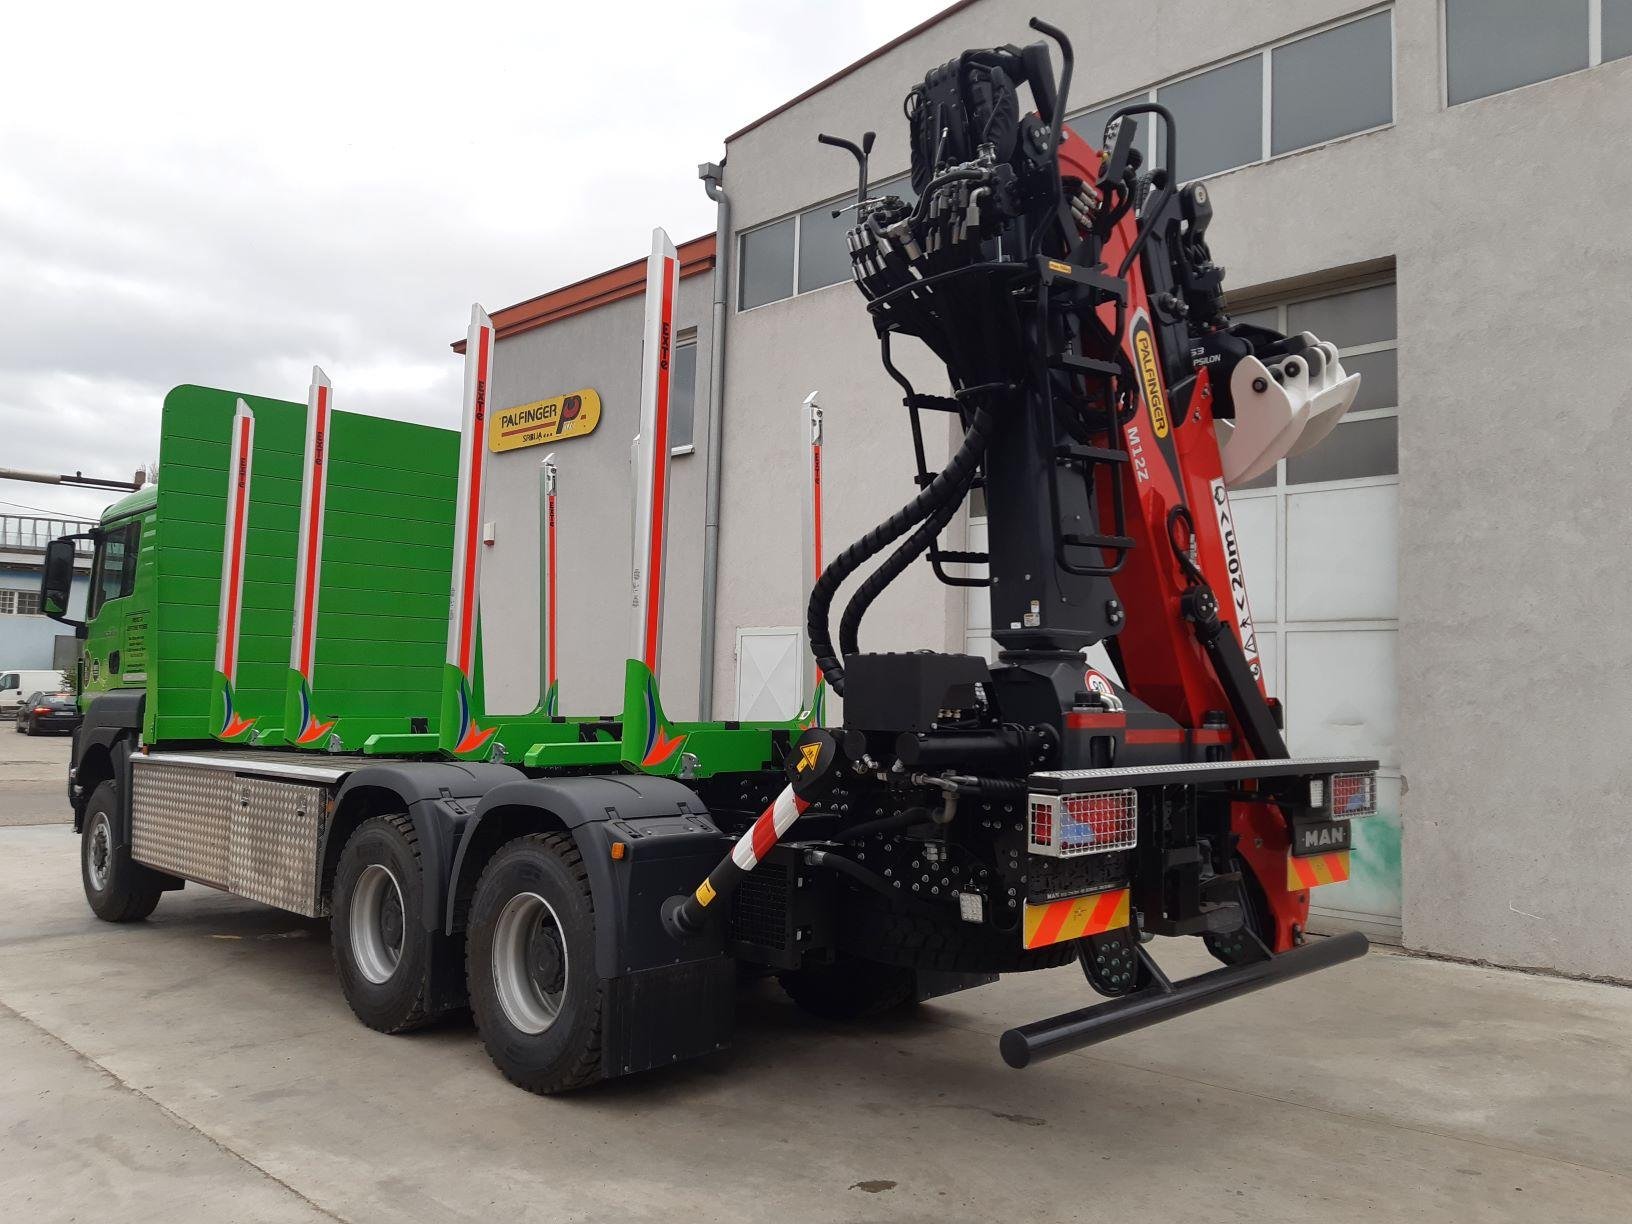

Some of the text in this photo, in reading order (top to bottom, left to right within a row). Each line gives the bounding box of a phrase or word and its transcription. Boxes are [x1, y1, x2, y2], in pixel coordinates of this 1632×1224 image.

[1193, 353, 1221, 366] PSILON
[1138, 336, 1166, 431] PALFINGER
[501, 404, 557, 429] PALFINGER
[1127, 426, 1149, 483] M12Z
[1305, 827, 1343, 848] MAN
